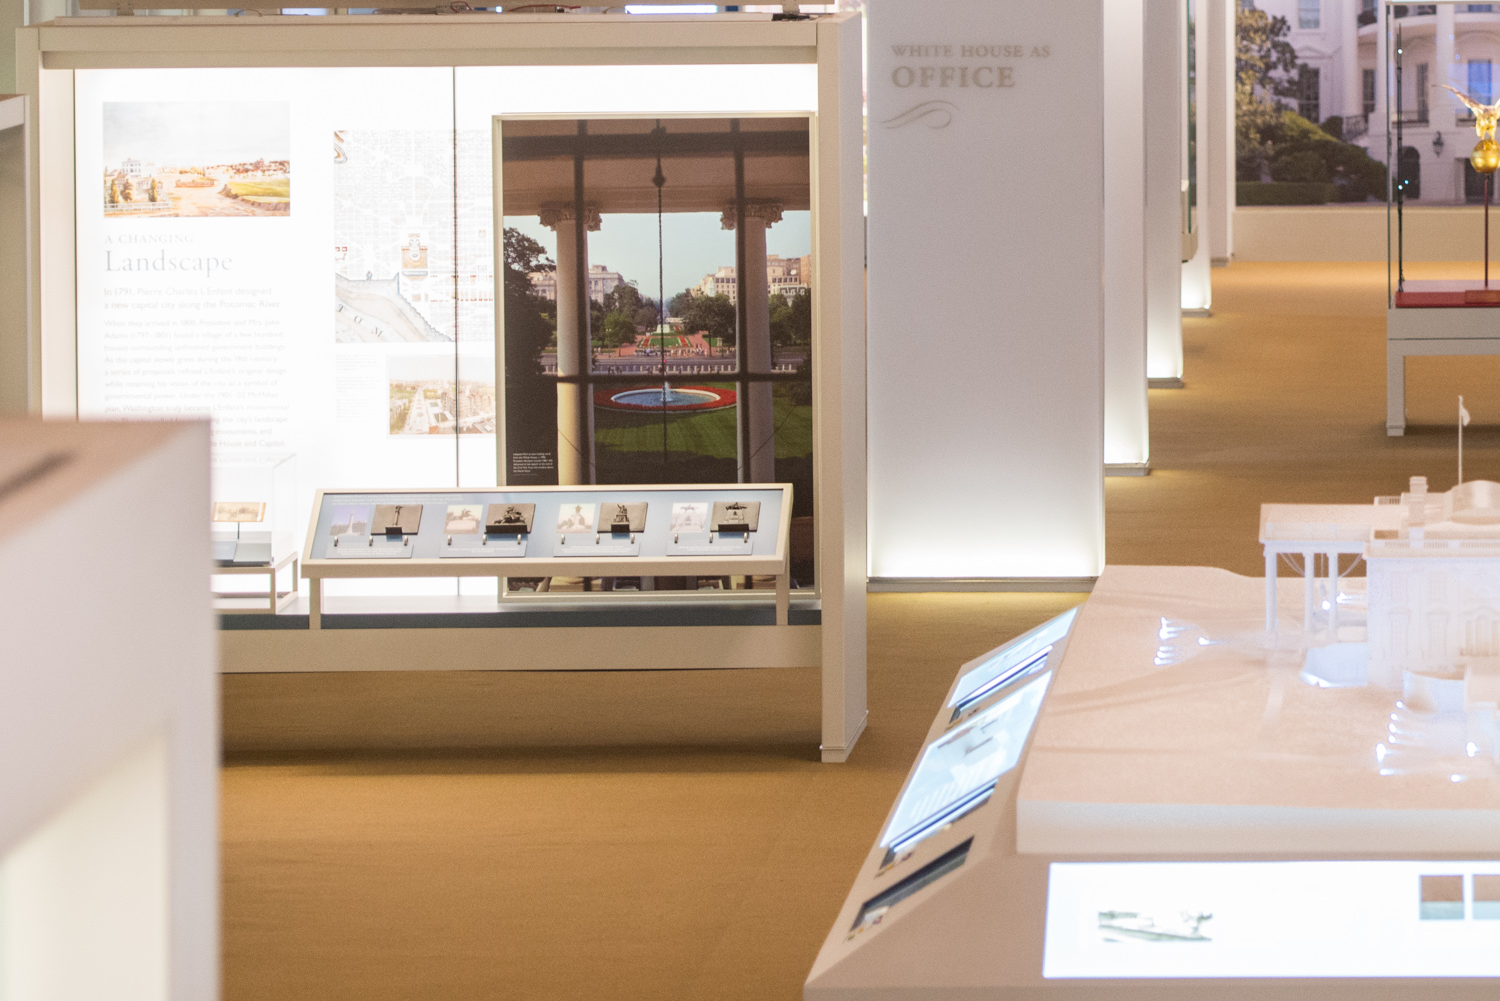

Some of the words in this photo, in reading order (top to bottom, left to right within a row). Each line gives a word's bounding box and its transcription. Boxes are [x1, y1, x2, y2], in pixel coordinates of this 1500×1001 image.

[892, 44, 953, 57] WHITE
[961, 44, 1024, 57] HOUSE
[1030, 45, 1050, 57] AS
[891, 65, 1016, 88] OFFICE
[104, 235, 112, 244] A
[118, 234, 194, 244] CHANGING
[106, 249, 232, 278] Landscape
[104, 287, 112, 296] In
[137, 287, 163, 296] Pierre
[165, 287, 198, 296] Charles
[236, 286, 272, 297] designed
[131, 300, 158, 311] capital
[161, 300, 175, 311] city
[178, 300, 200, 311] along
[203, 300, 217, 309] the
[219, 300, 256, 309] Potomac
